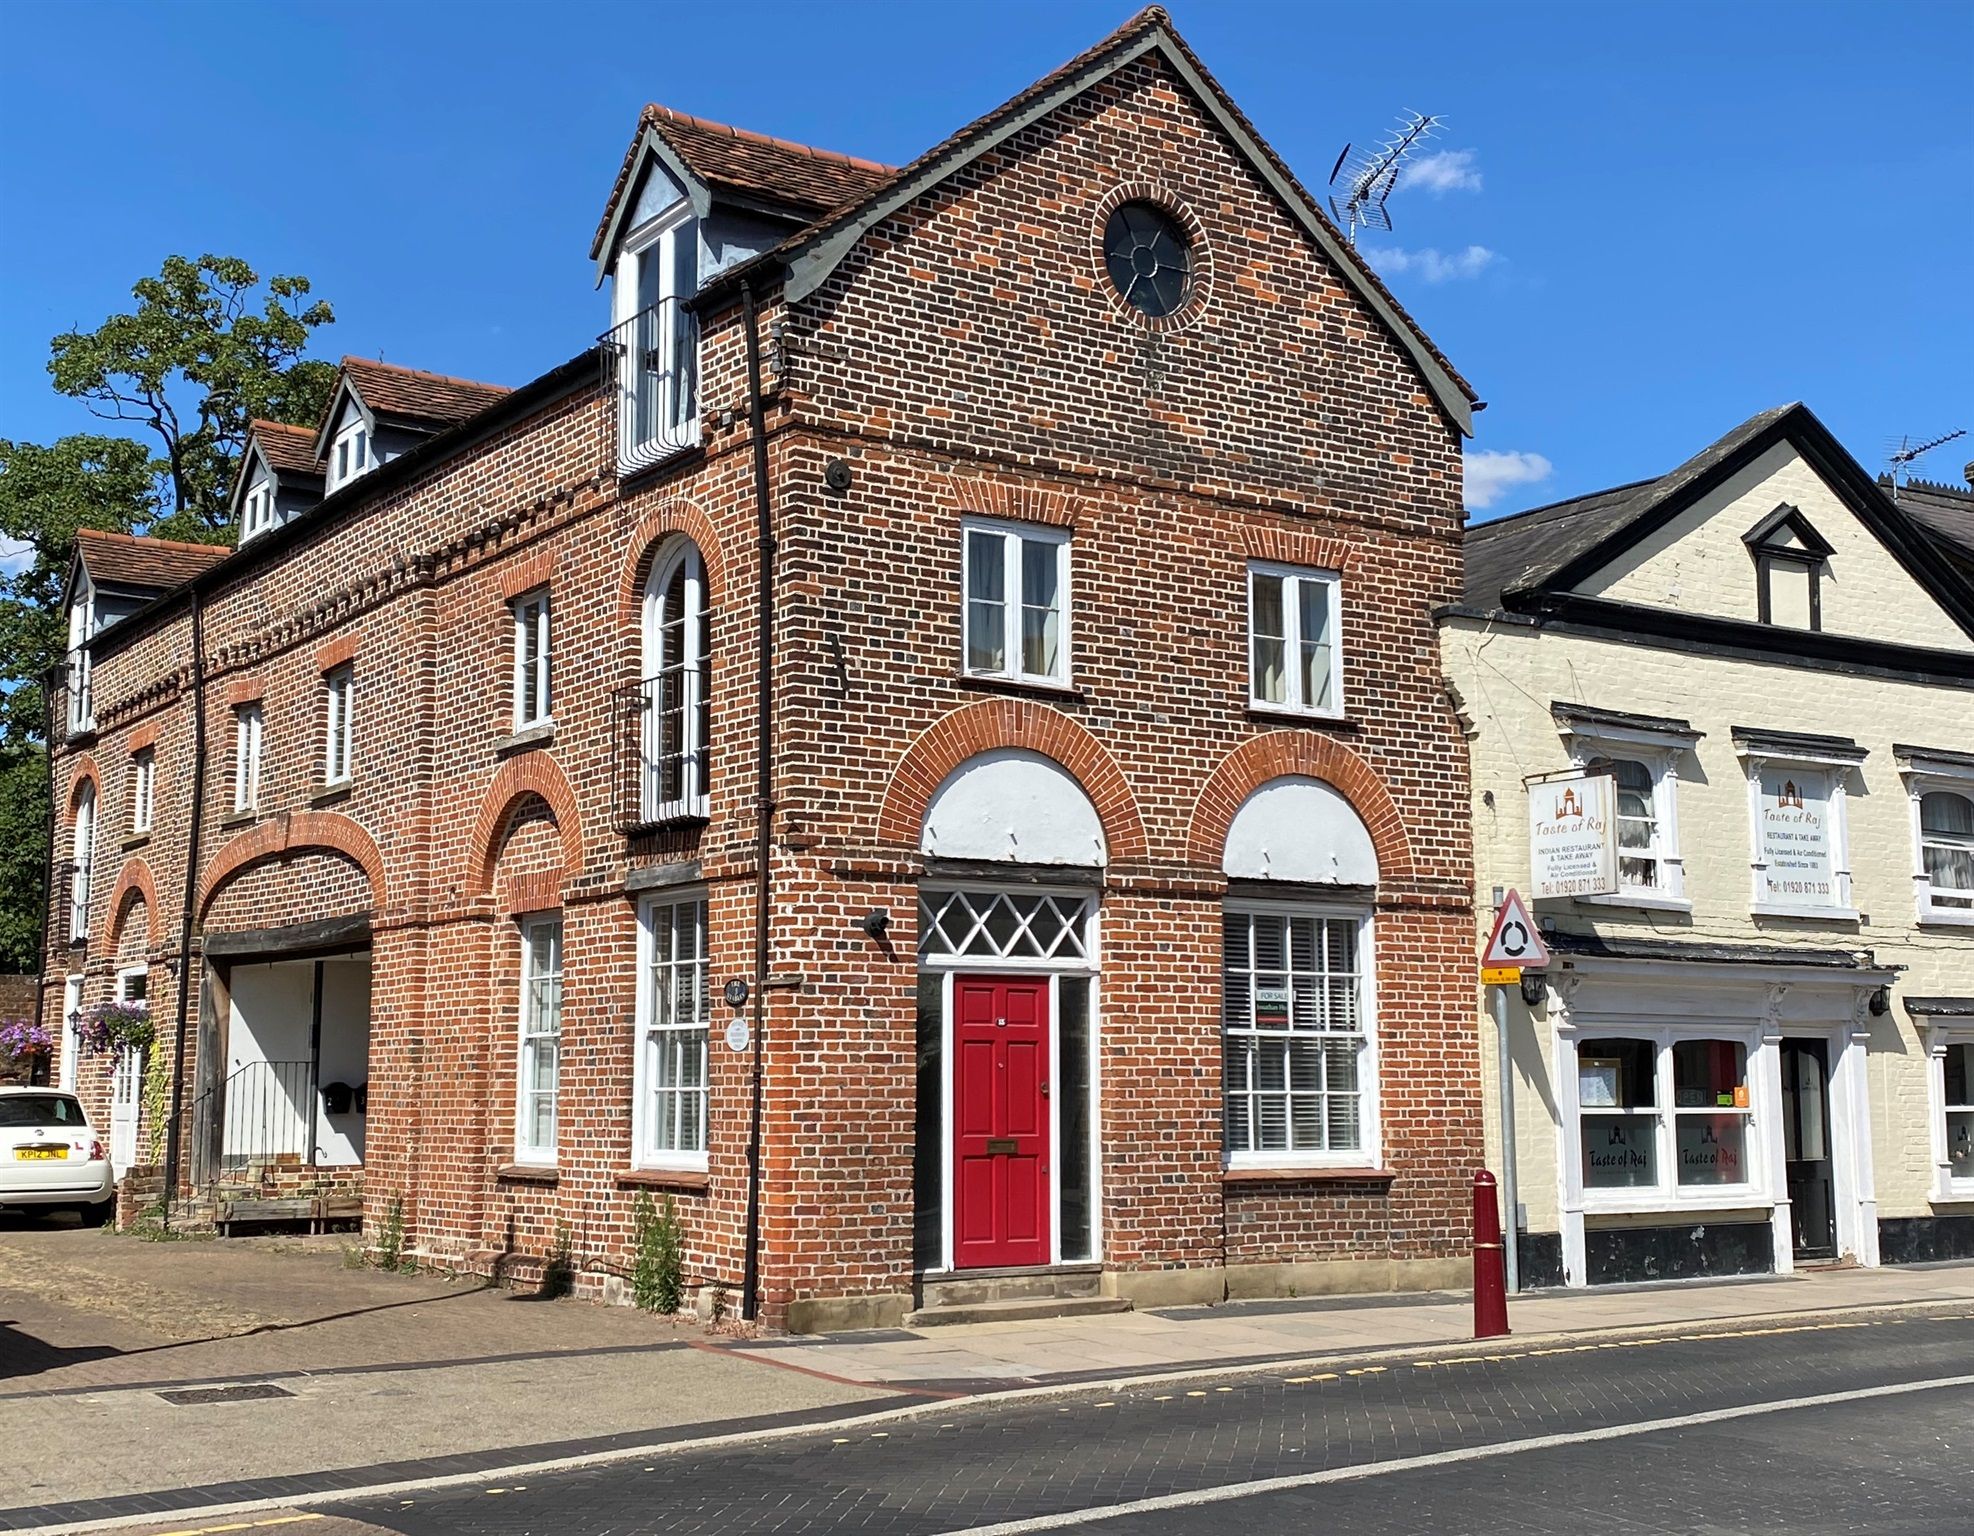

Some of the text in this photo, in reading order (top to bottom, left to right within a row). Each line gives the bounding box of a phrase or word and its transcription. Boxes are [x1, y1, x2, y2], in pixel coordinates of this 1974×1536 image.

[1536, 816, 1607, 835] Taste of Raj
[1764, 809, 1821, 829] Taste of Raj
[1538, 842, 1605, 855] INDIAN RESTAURANT
[1557, 853, 1573, 861] TAKE
[1575, 851, 1593, 859] AWAY
[1563, 862, 1591, 870] Licensed
[1541, 881, 1554, 895] Tel:
[1556, 879, 1576, 894] 01920
[1593, 877, 1606, 890] 333
[1783, 881, 1803, 894] 01920
[1804, 882, 1816, 894] 871
[1817, 882, 1830, 895] 333
[1261, 992, 1273, 1000] FOR
[1589, 1149, 1647, 1168] Taste of Raj
[1682, 1148, 1737, 1167] Taste of Raj
